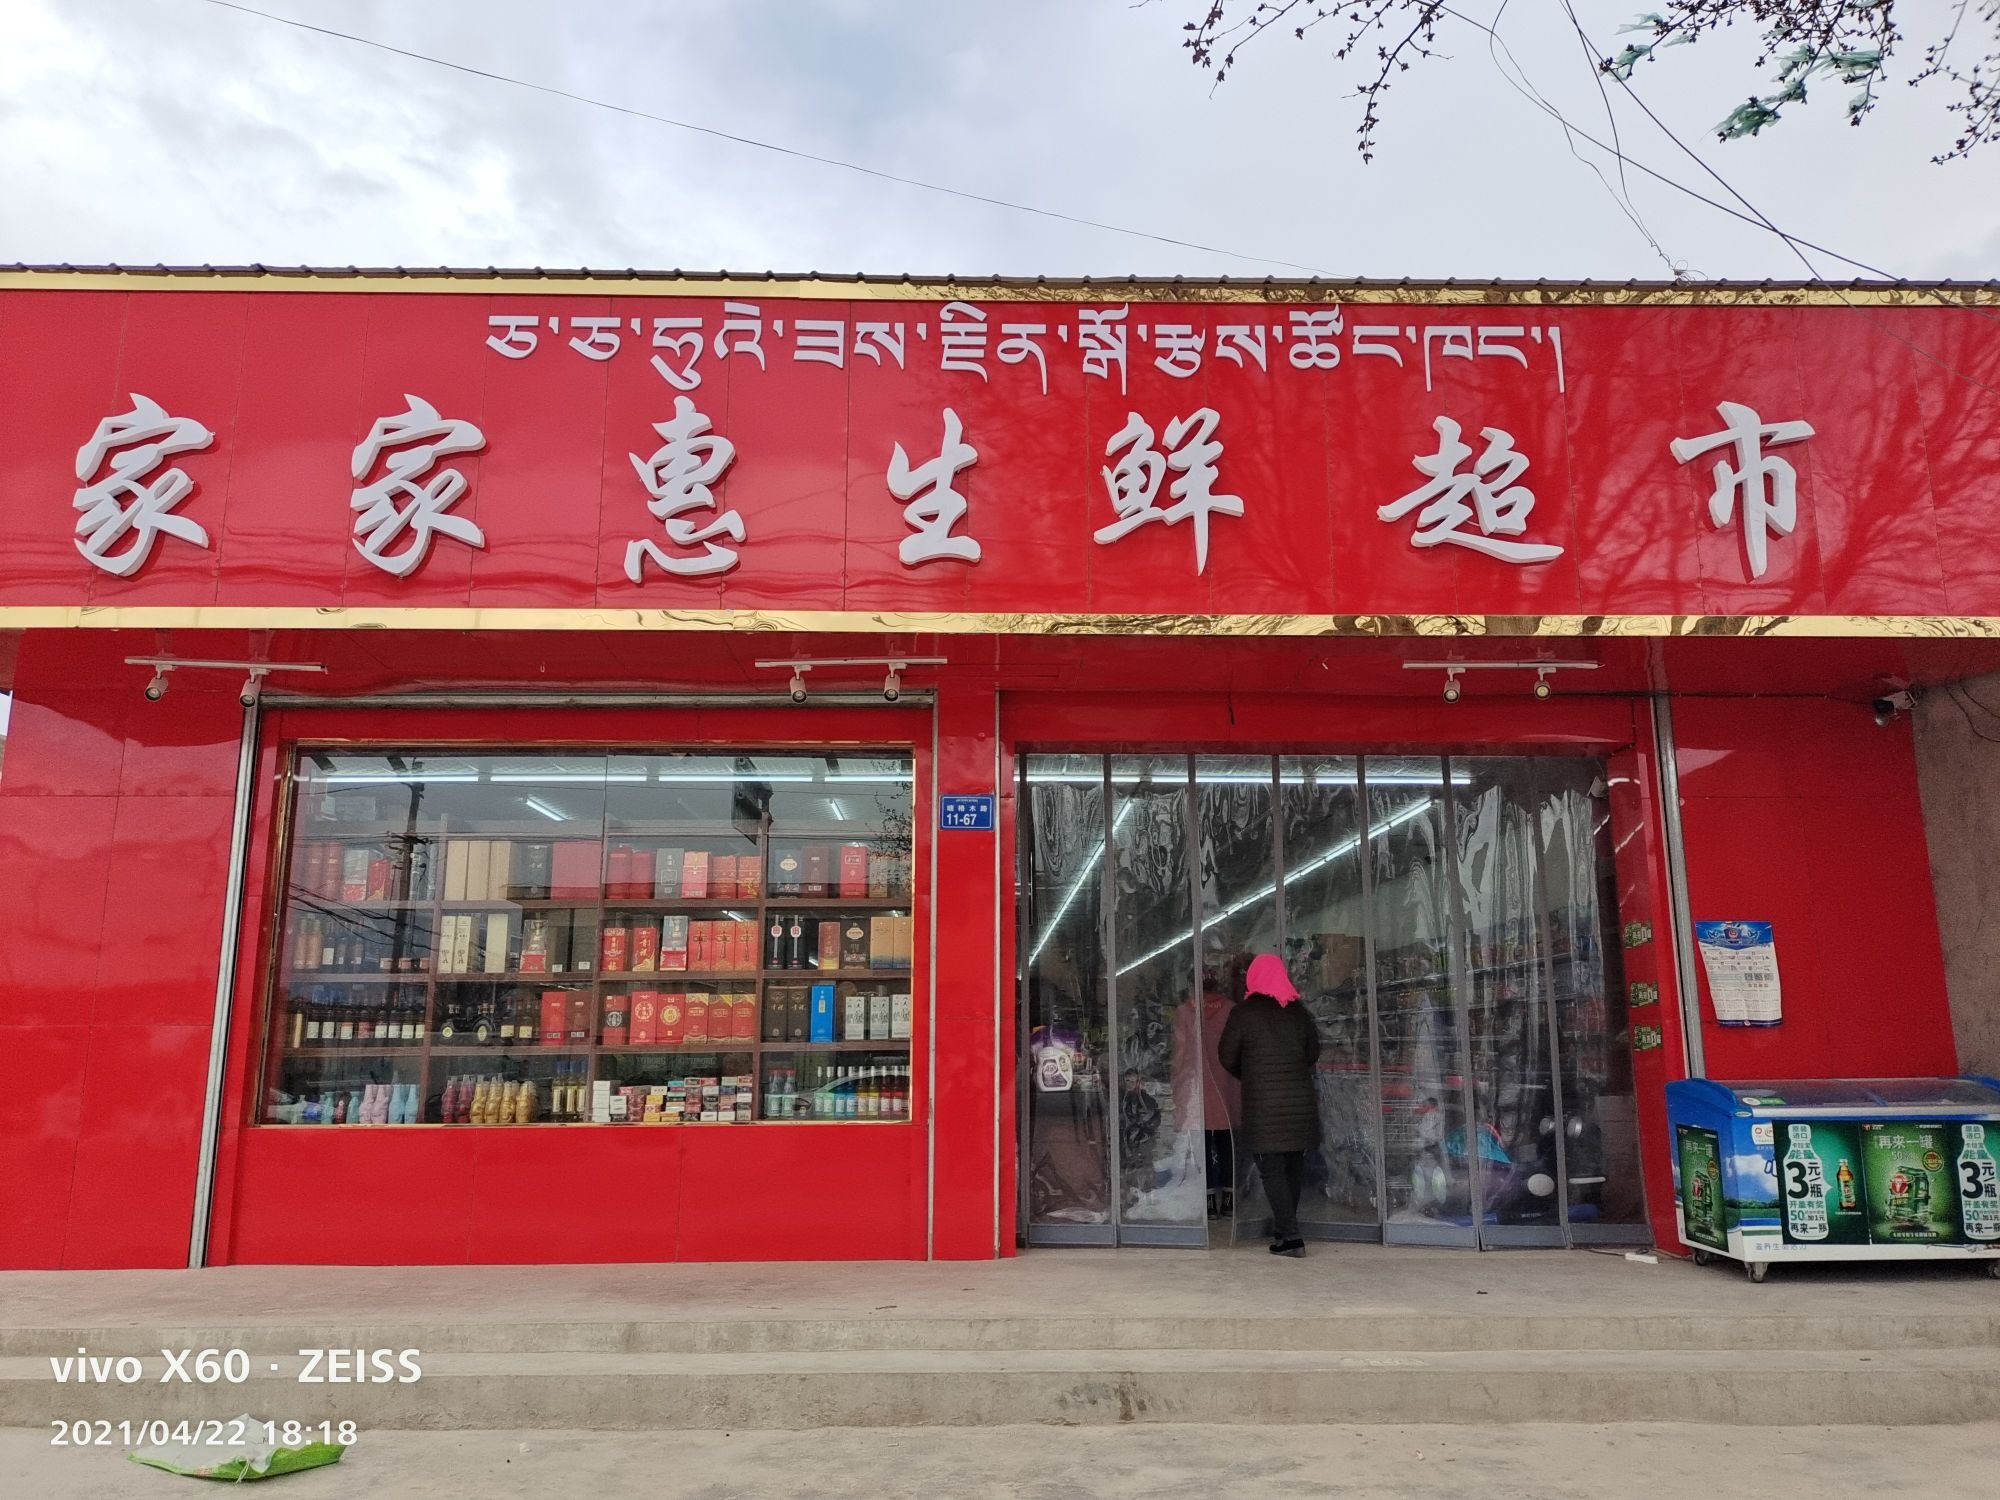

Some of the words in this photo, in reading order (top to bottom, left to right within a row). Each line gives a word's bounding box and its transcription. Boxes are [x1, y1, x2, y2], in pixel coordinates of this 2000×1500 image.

[73, 393, 1816, 582] 家家惠生鲜超市
[946, 813, 977, 825] 11-67
[1879, 1134, 1934, 1149] 再来一罐
[1788, 1149, 1815, 1159] 能量
[1962, 1149, 1990, 1160] 能量
[1786, 1161, 1809, 1199] 3
[1960, 1161, 1984, 1199] 3
[1789, 1200, 1824, 1209] 开盖有奖
[1963, 1200, 1998, 1209] 开盖有奖
[1790, 1222, 1828, 1234] 再来一瓶
